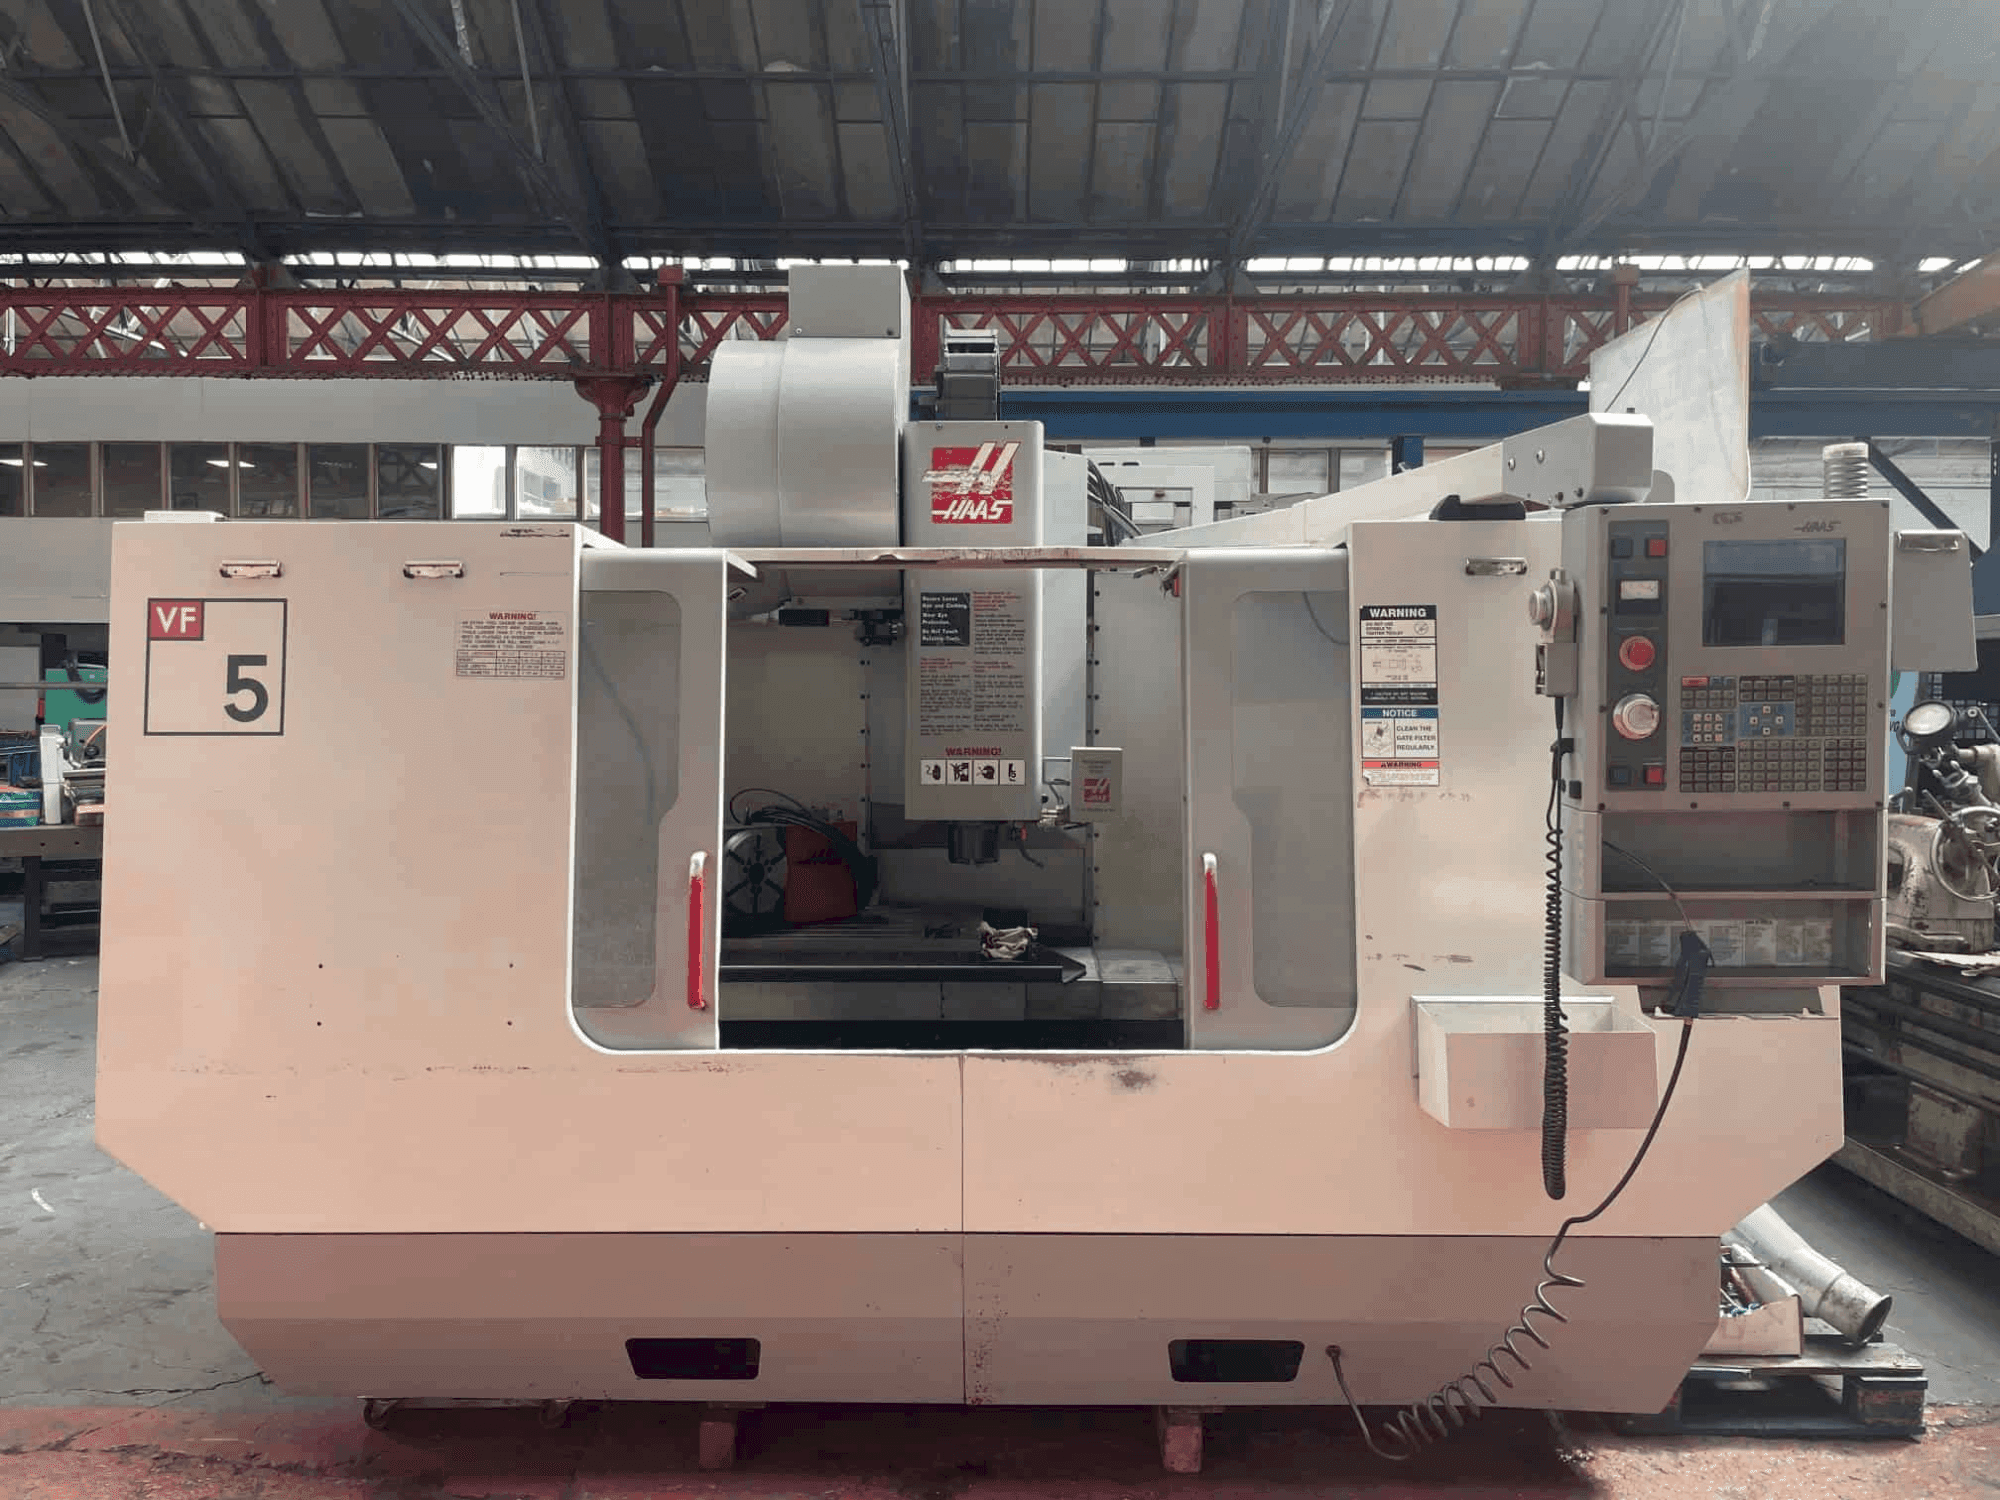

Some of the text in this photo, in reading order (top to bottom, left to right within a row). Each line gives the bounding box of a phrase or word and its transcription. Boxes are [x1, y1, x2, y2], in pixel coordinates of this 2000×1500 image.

[931, 499, 1013, 520] HAAS
[489, 612, 537, 620] WARNING!
[1369, 608, 1427, 618] WARNING
[156, 605, 196, 633] VF
[224, 654, 269, 722] 5
[1382, 709, 1418, 718] NOTICE
[945, 746, 1002, 755] WARNING!
